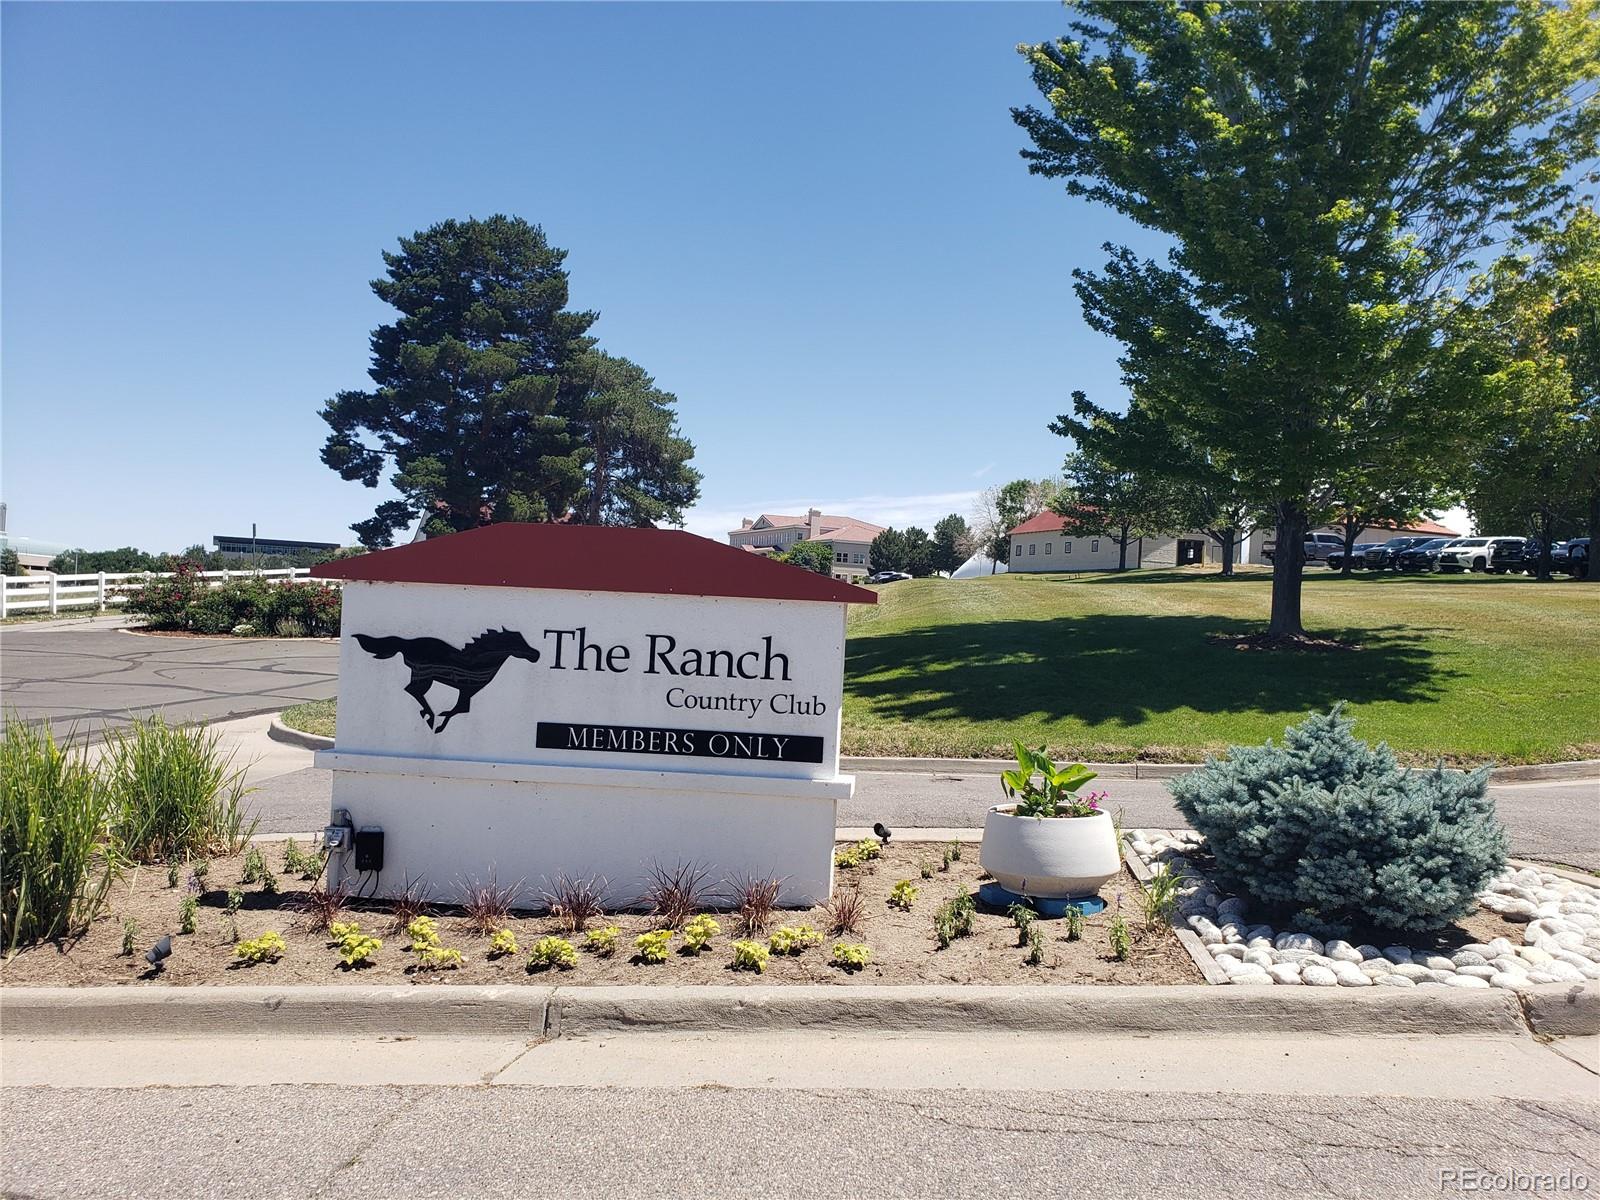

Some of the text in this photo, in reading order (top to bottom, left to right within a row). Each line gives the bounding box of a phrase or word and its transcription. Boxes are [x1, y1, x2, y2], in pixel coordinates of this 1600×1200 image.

[543, 627, 792, 681] The Ranch
[666, 687, 827, 719] Country Club
[567, 727, 790, 760] MEMBERS ONLY
